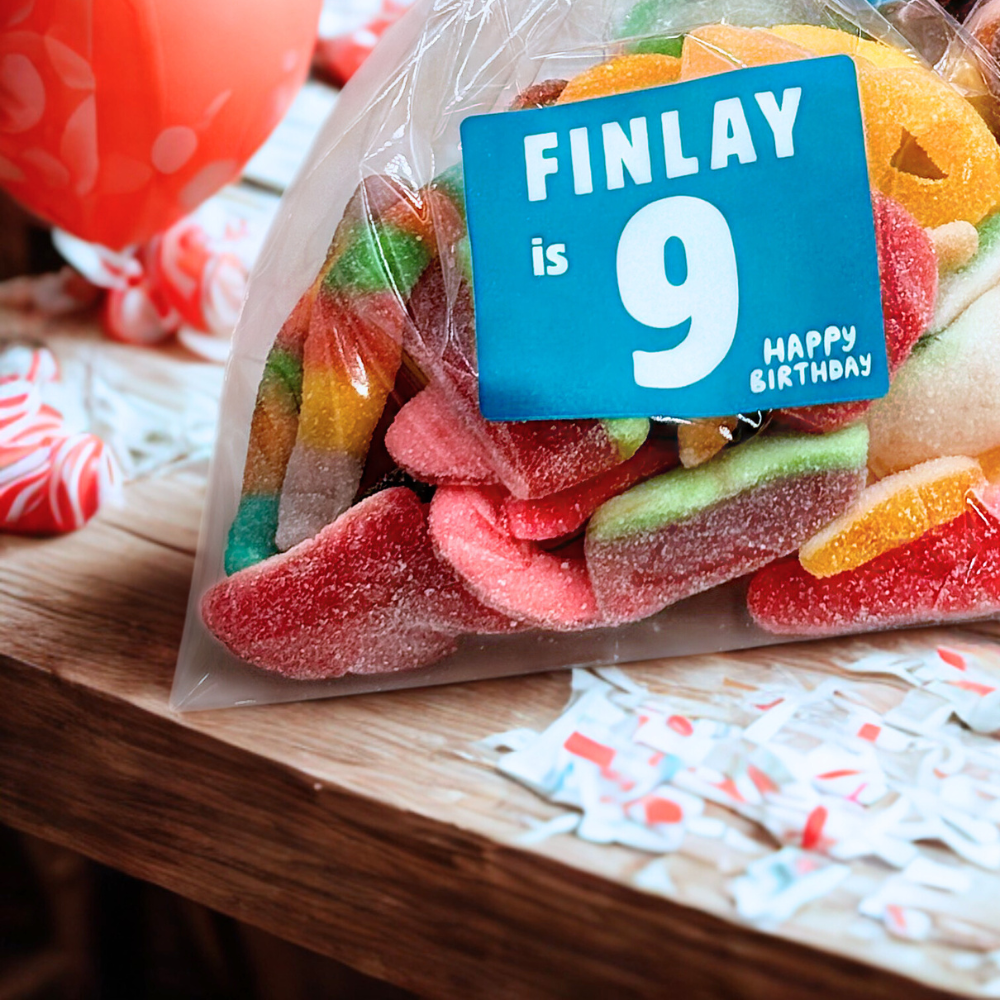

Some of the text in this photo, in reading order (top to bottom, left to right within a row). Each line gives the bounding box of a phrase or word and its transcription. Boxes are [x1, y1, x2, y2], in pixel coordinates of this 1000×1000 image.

[523, 86, 803, 203] FINLAY
[530, 194, 740, 389] is 9
[749, 352, 872, 394] BIRTHDAY
[763, 324, 857, 364] HAPPY
